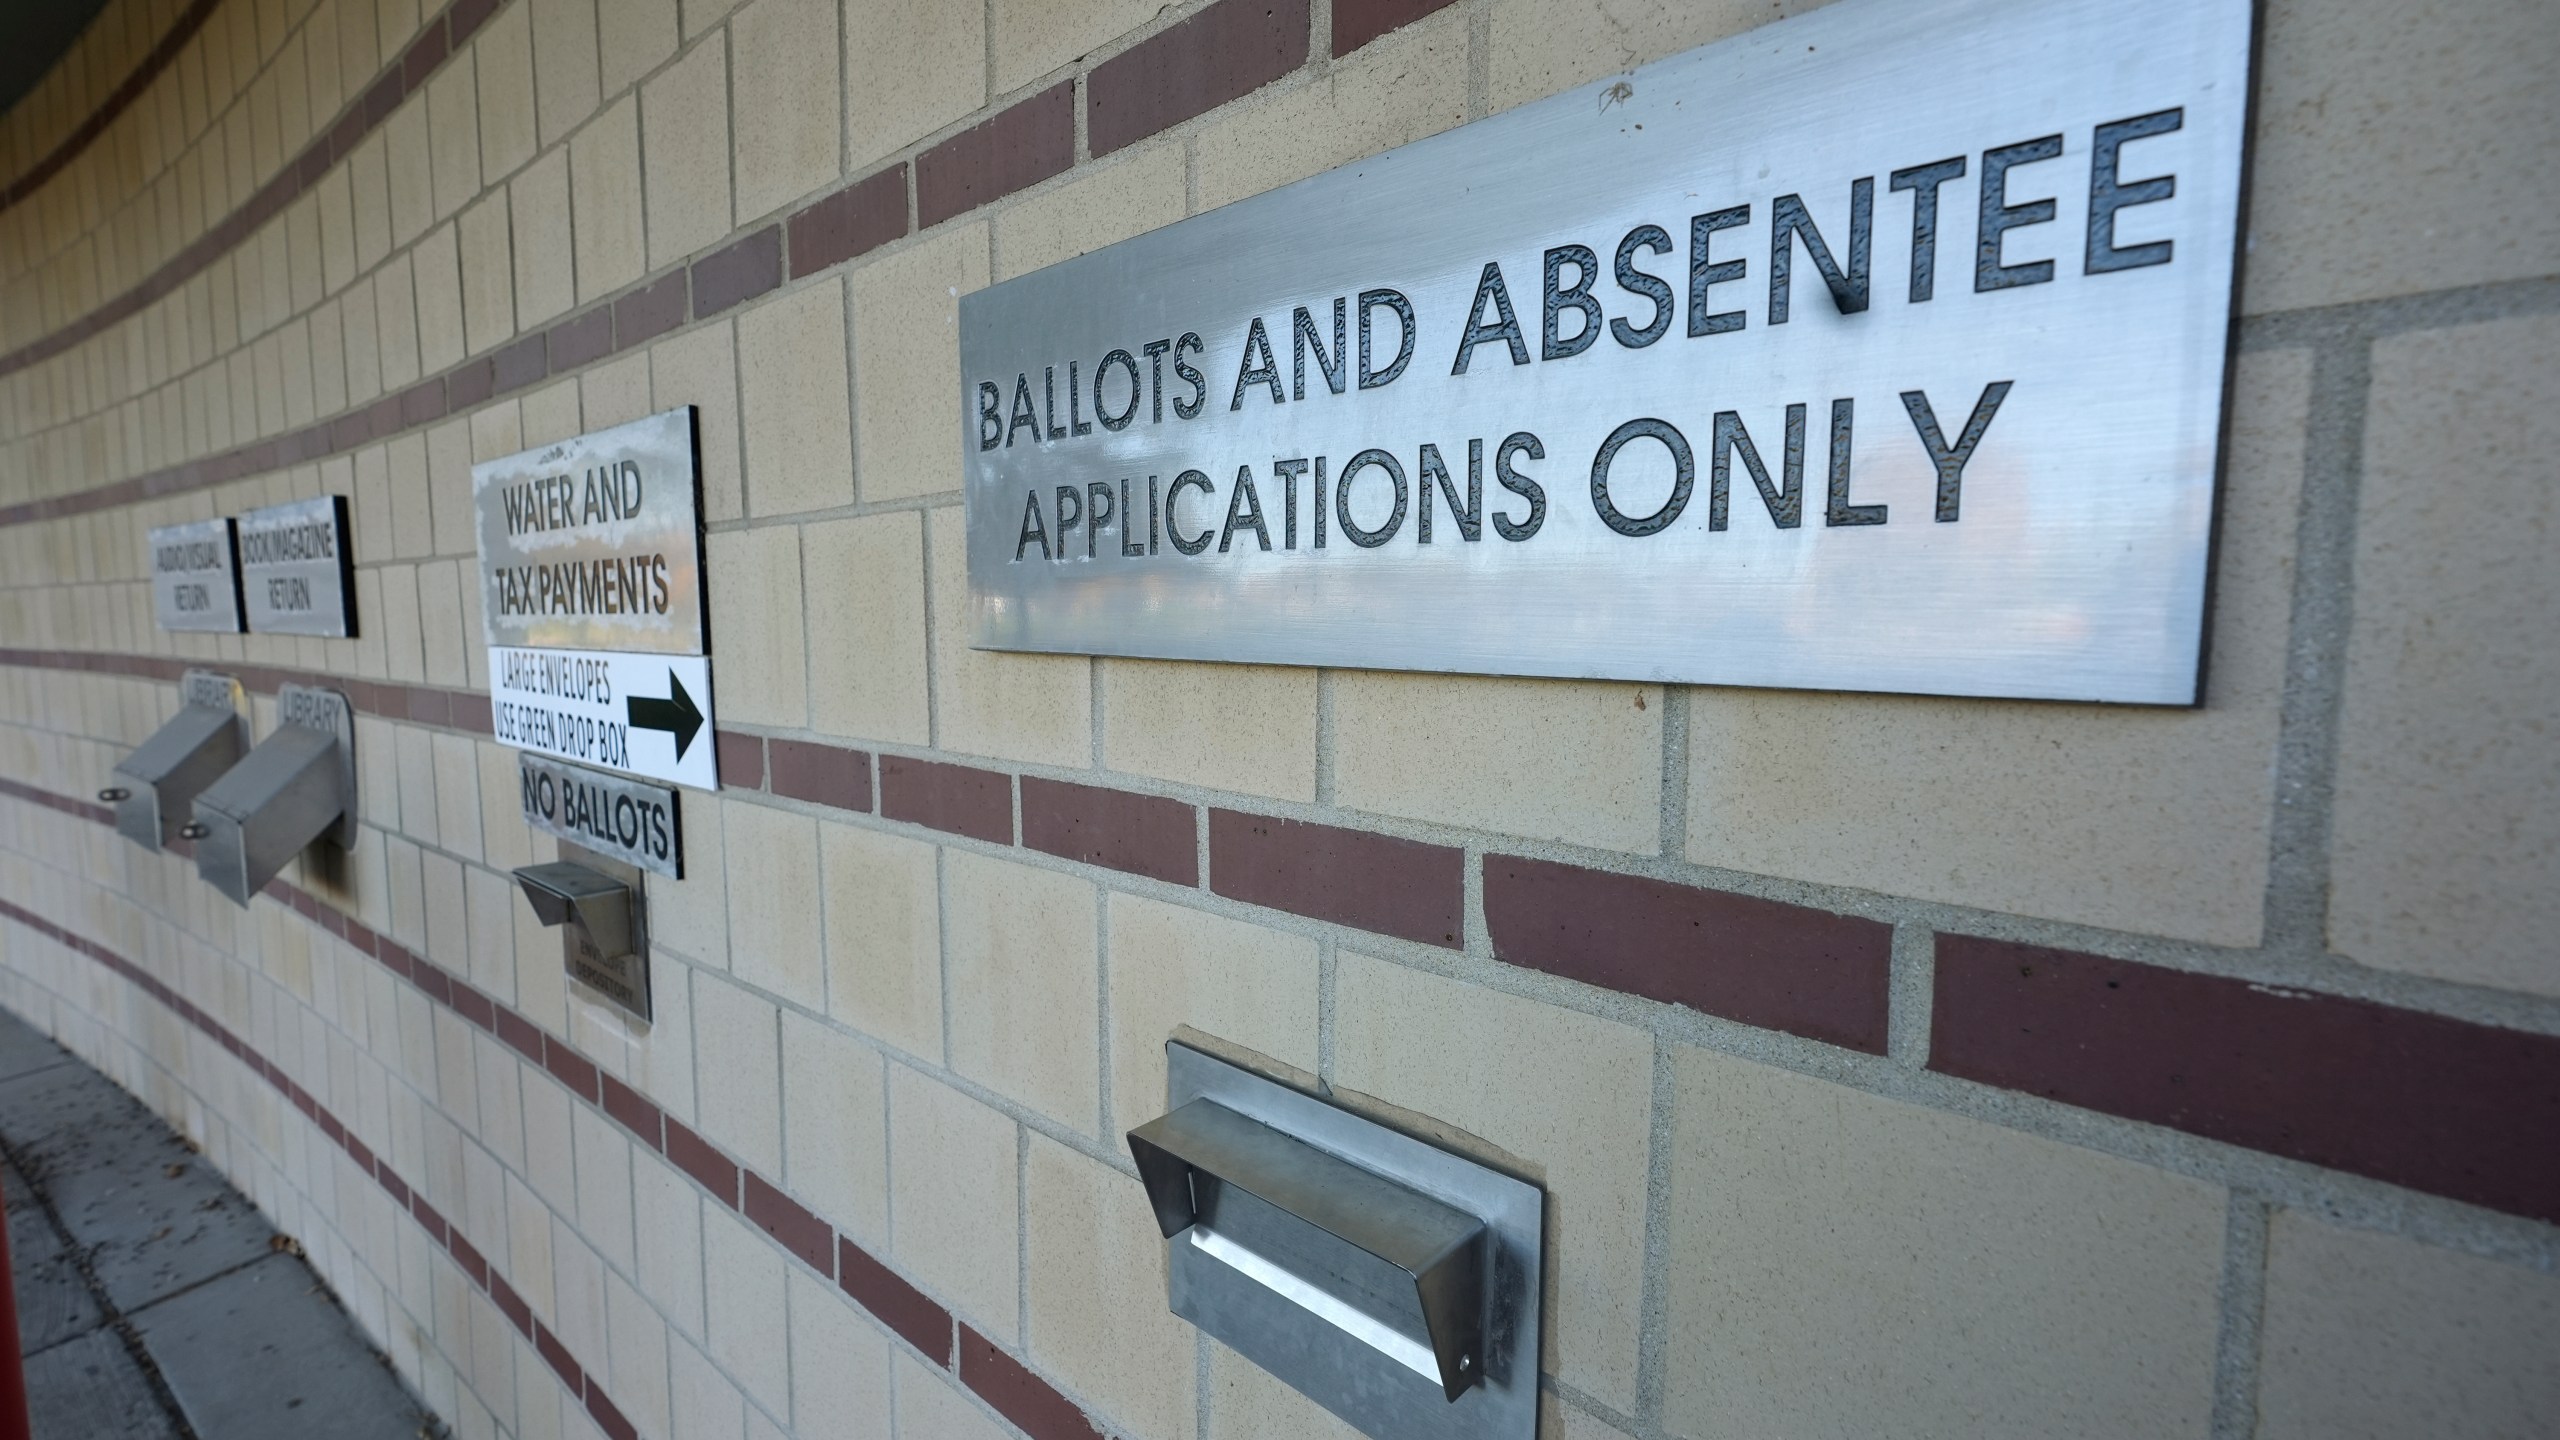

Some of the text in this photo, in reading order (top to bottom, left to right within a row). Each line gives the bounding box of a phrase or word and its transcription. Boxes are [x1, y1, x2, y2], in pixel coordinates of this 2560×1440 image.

[978, 106, 2184, 452] BALLOTS AND ABSENTEE
[502, 459, 643, 536] WATER AND
[1016, 380, 2014, 561] APPLICATIONS ONLY
[173, 583, 211, 611] RETURN
[268, 577, 312, 611] RETURN
[495, 553, 668, 615] TAX PAYMENTS
[284, 690, 342, 731] LIBRARY
[500, 651, 611, 706] LARGE ENVELOPES
[495, 701, 630, 769] USE GREEN DROP BOX
[522, 766, 668, 861] NO BALLOTS
